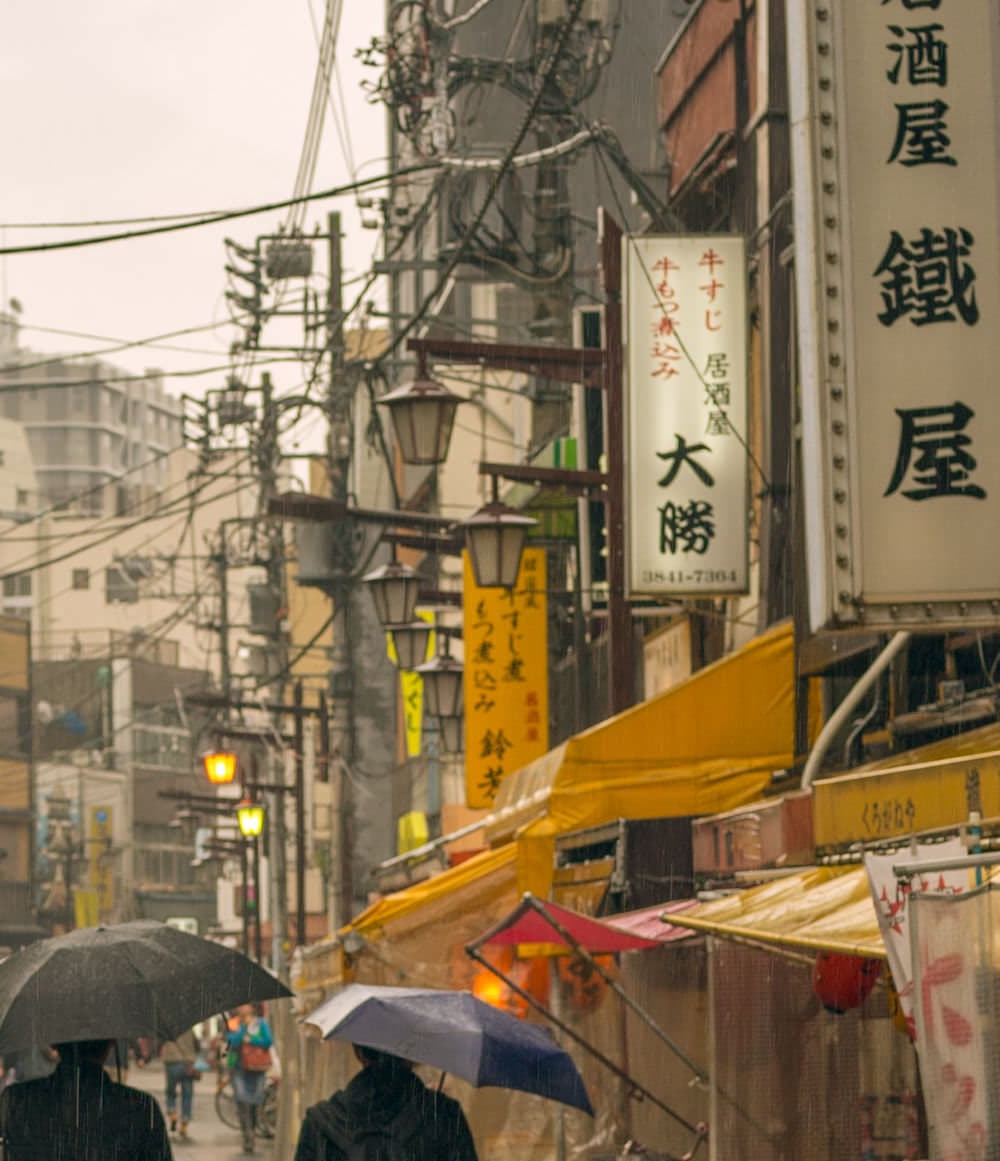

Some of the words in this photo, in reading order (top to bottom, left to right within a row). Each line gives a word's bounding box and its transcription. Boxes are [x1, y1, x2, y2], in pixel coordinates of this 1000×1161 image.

[880, 0, 958, 167] 酒屋
[651, 256, 681, 381] 牛もつ煮込み
[699, 248, 725, 333] 牛すじ
[703, 353, 731, 436] 居酒屋
[656, 433, 715, 555] 大勝
